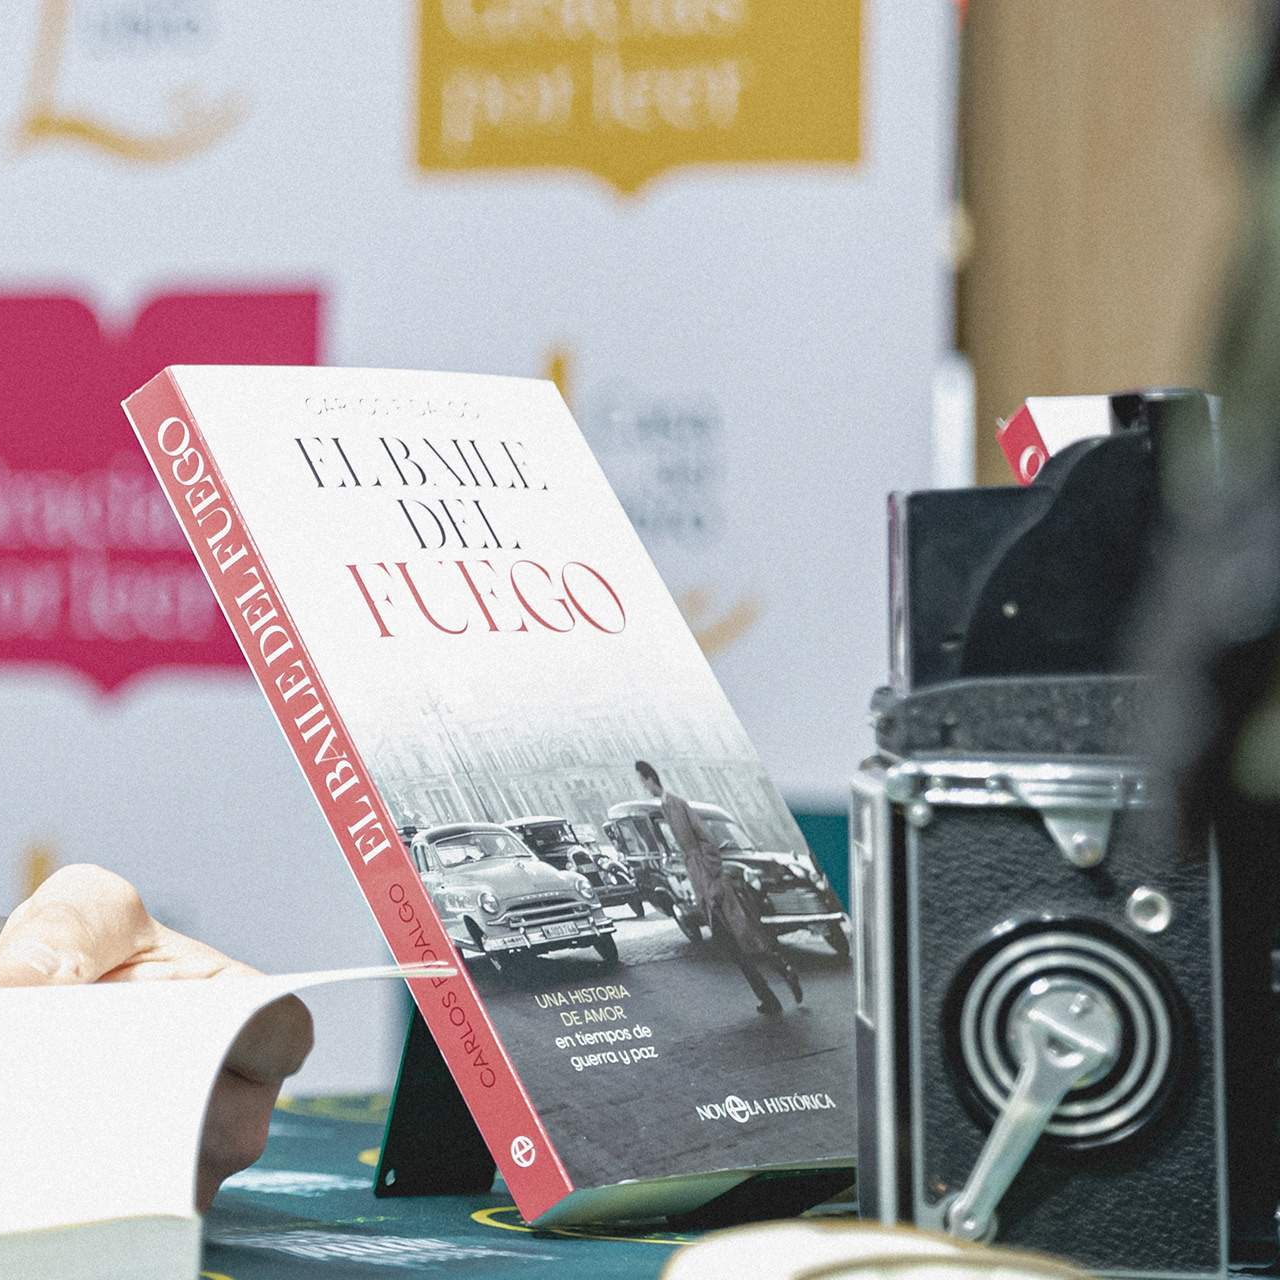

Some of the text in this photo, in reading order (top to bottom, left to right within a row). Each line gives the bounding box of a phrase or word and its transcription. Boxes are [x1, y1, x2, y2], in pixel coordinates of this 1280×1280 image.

[441, 38, 750, 160] por leer
[294, 436, 549, 491] EL BAILE
[396, 499, 522, 550] DEL
[345, 559, 627, 638] FUEGO
[157, 416, 392, 866] EL BAILE DEL FUEGO
[389, 883, 496, 1088] CARLOS FDALGO
[534, 984, 631, 1008] UNA HISTORIA
[555, 1024, 652, 1049] en tiempos de
[560, 1005, 627, 1026] DE AMOR
[570, 1046, 659, 1071] guerra y paz
[763, 1092, 837, 1114] HISTÓRICA
